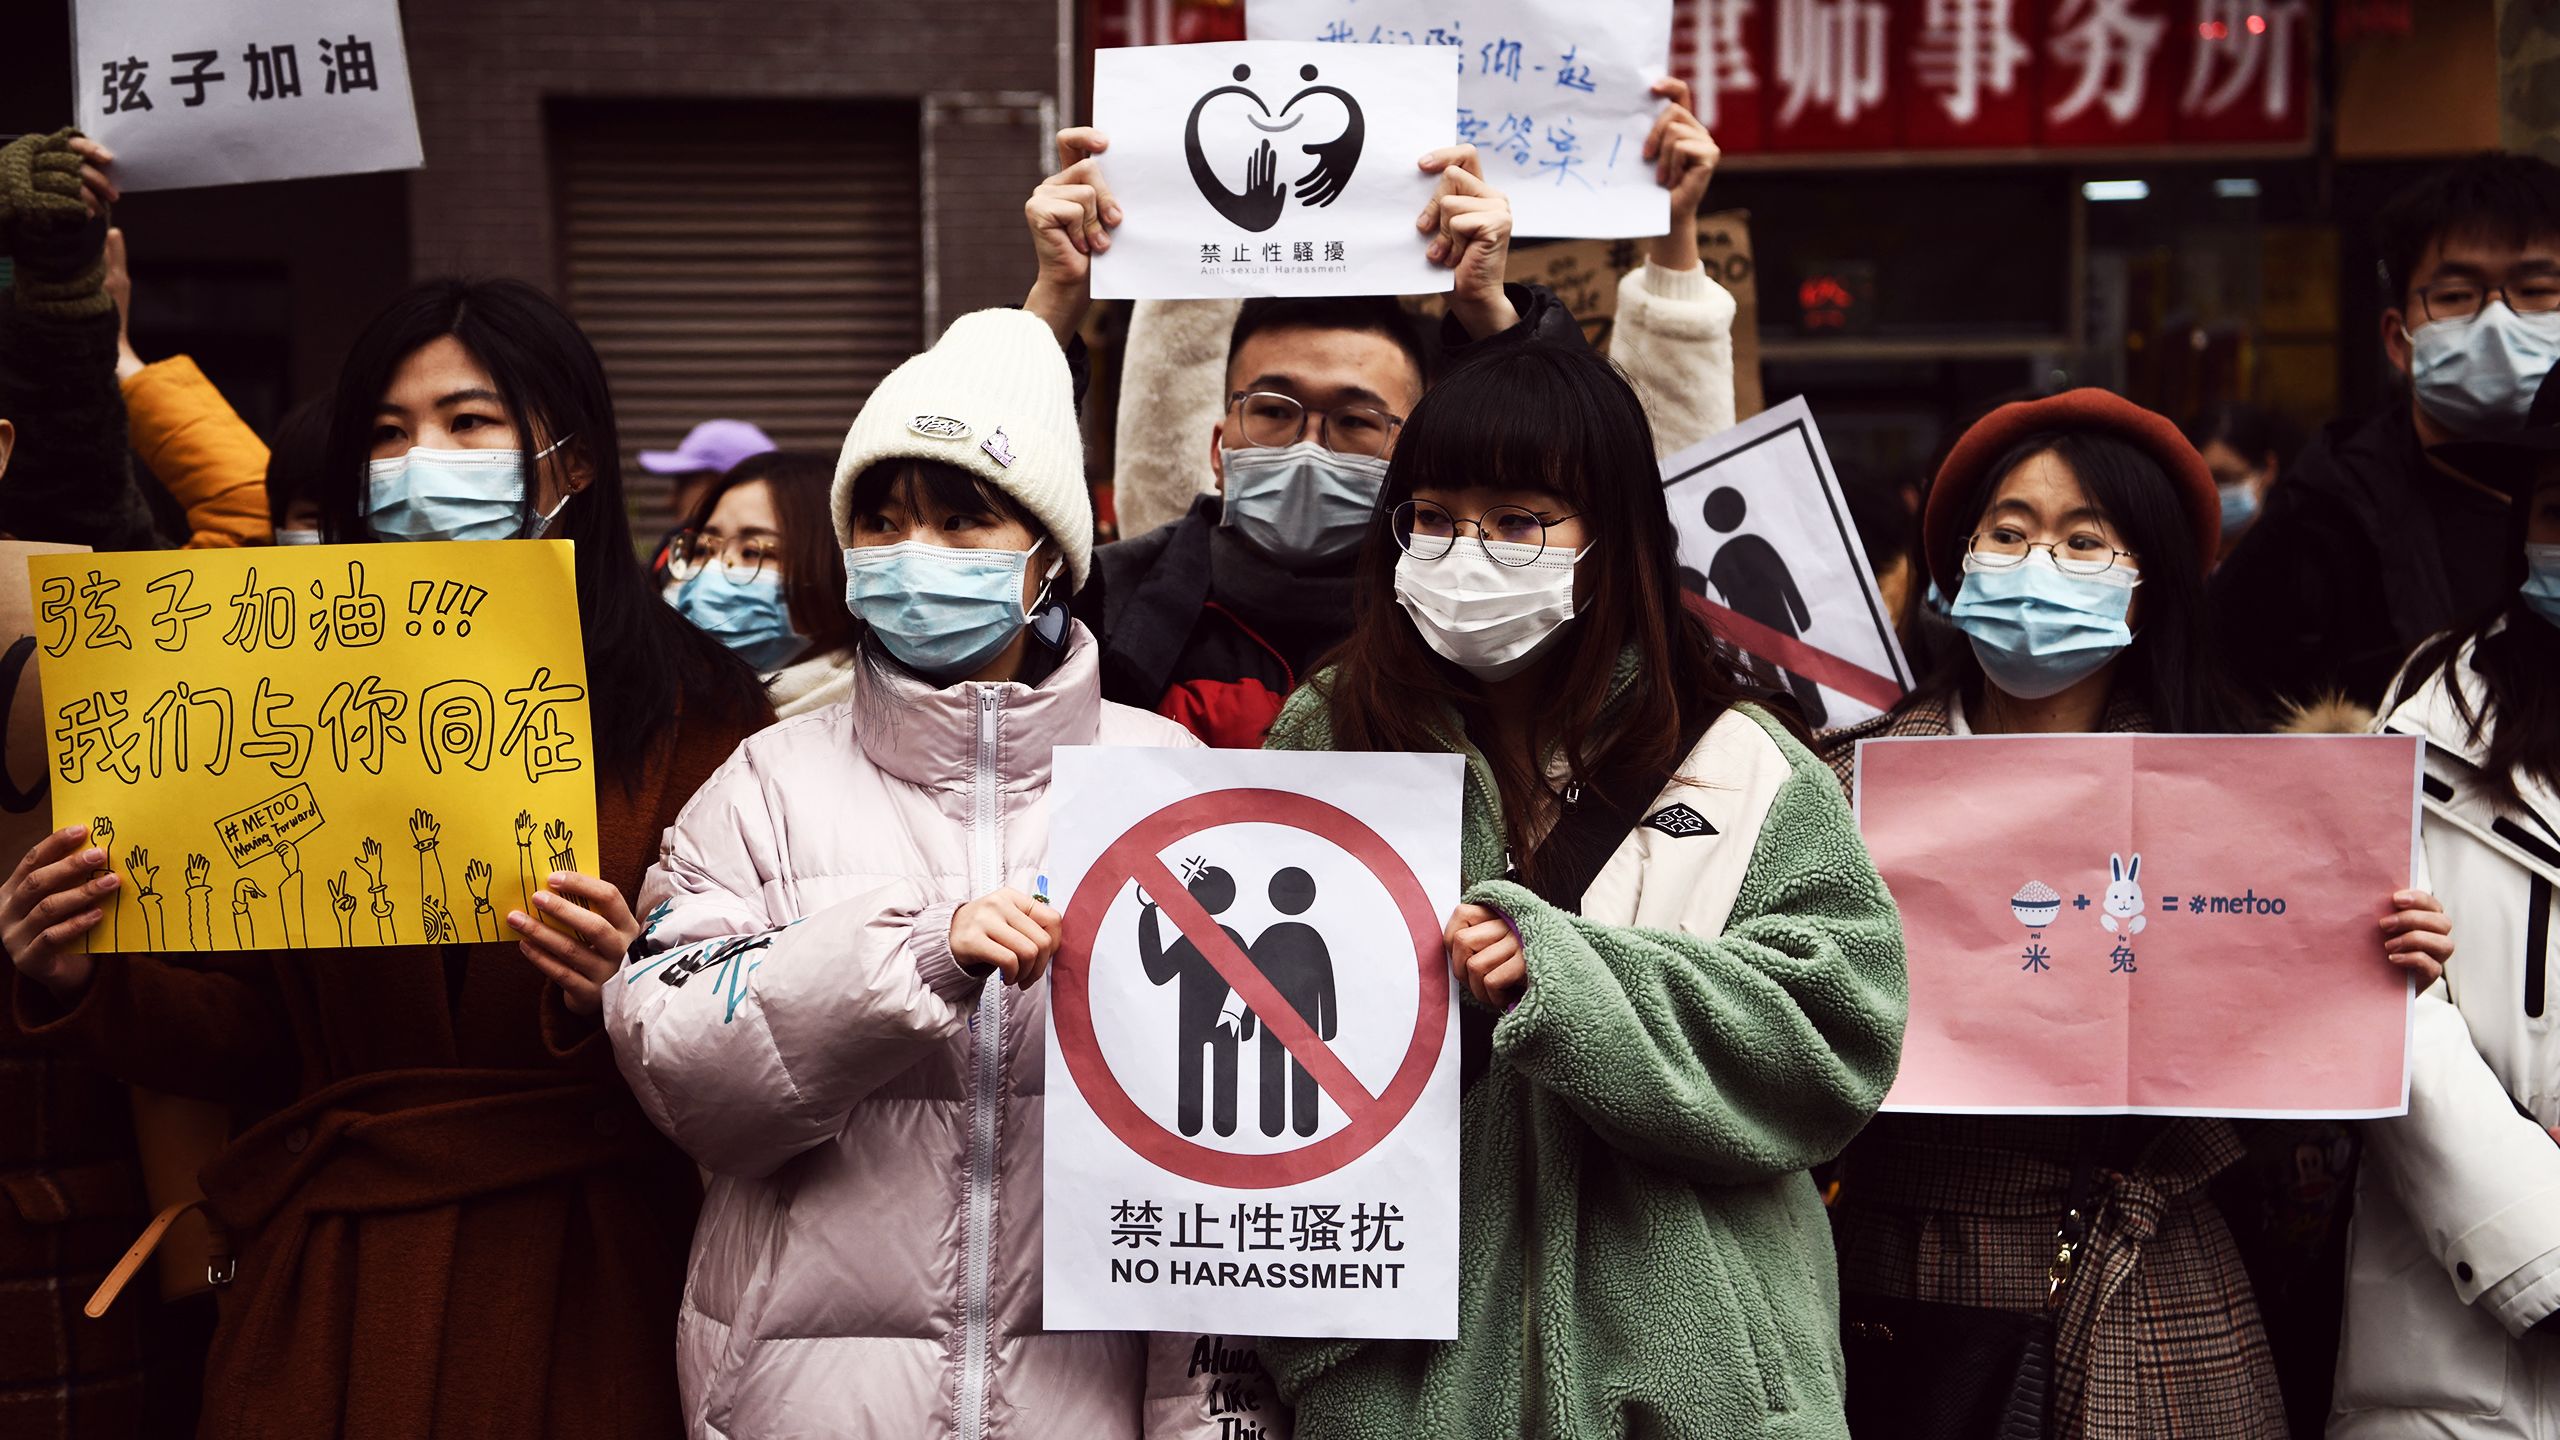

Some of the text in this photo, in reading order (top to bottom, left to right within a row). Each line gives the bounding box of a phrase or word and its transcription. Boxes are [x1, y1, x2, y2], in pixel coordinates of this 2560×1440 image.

[102, 34, 379, 115] 弦子加油
[1200, 241, 1345, 263] 禁止性騷擾
[1275, 265, 1347, 273] Harassment
[56, 667, 585, 784] 我们与你同在
[234, 801, 316, 859] Moving Forward
[2022, 944, 2051, 973] 米
[2109, 945, 2138, 973] 兔
[1110, 1199, 1405, 1253] 禁止性骚扰
[1111, 1259, 1405, 1289] NO HARASSMENT
[1209, 1378, 1261, 1416] Like
